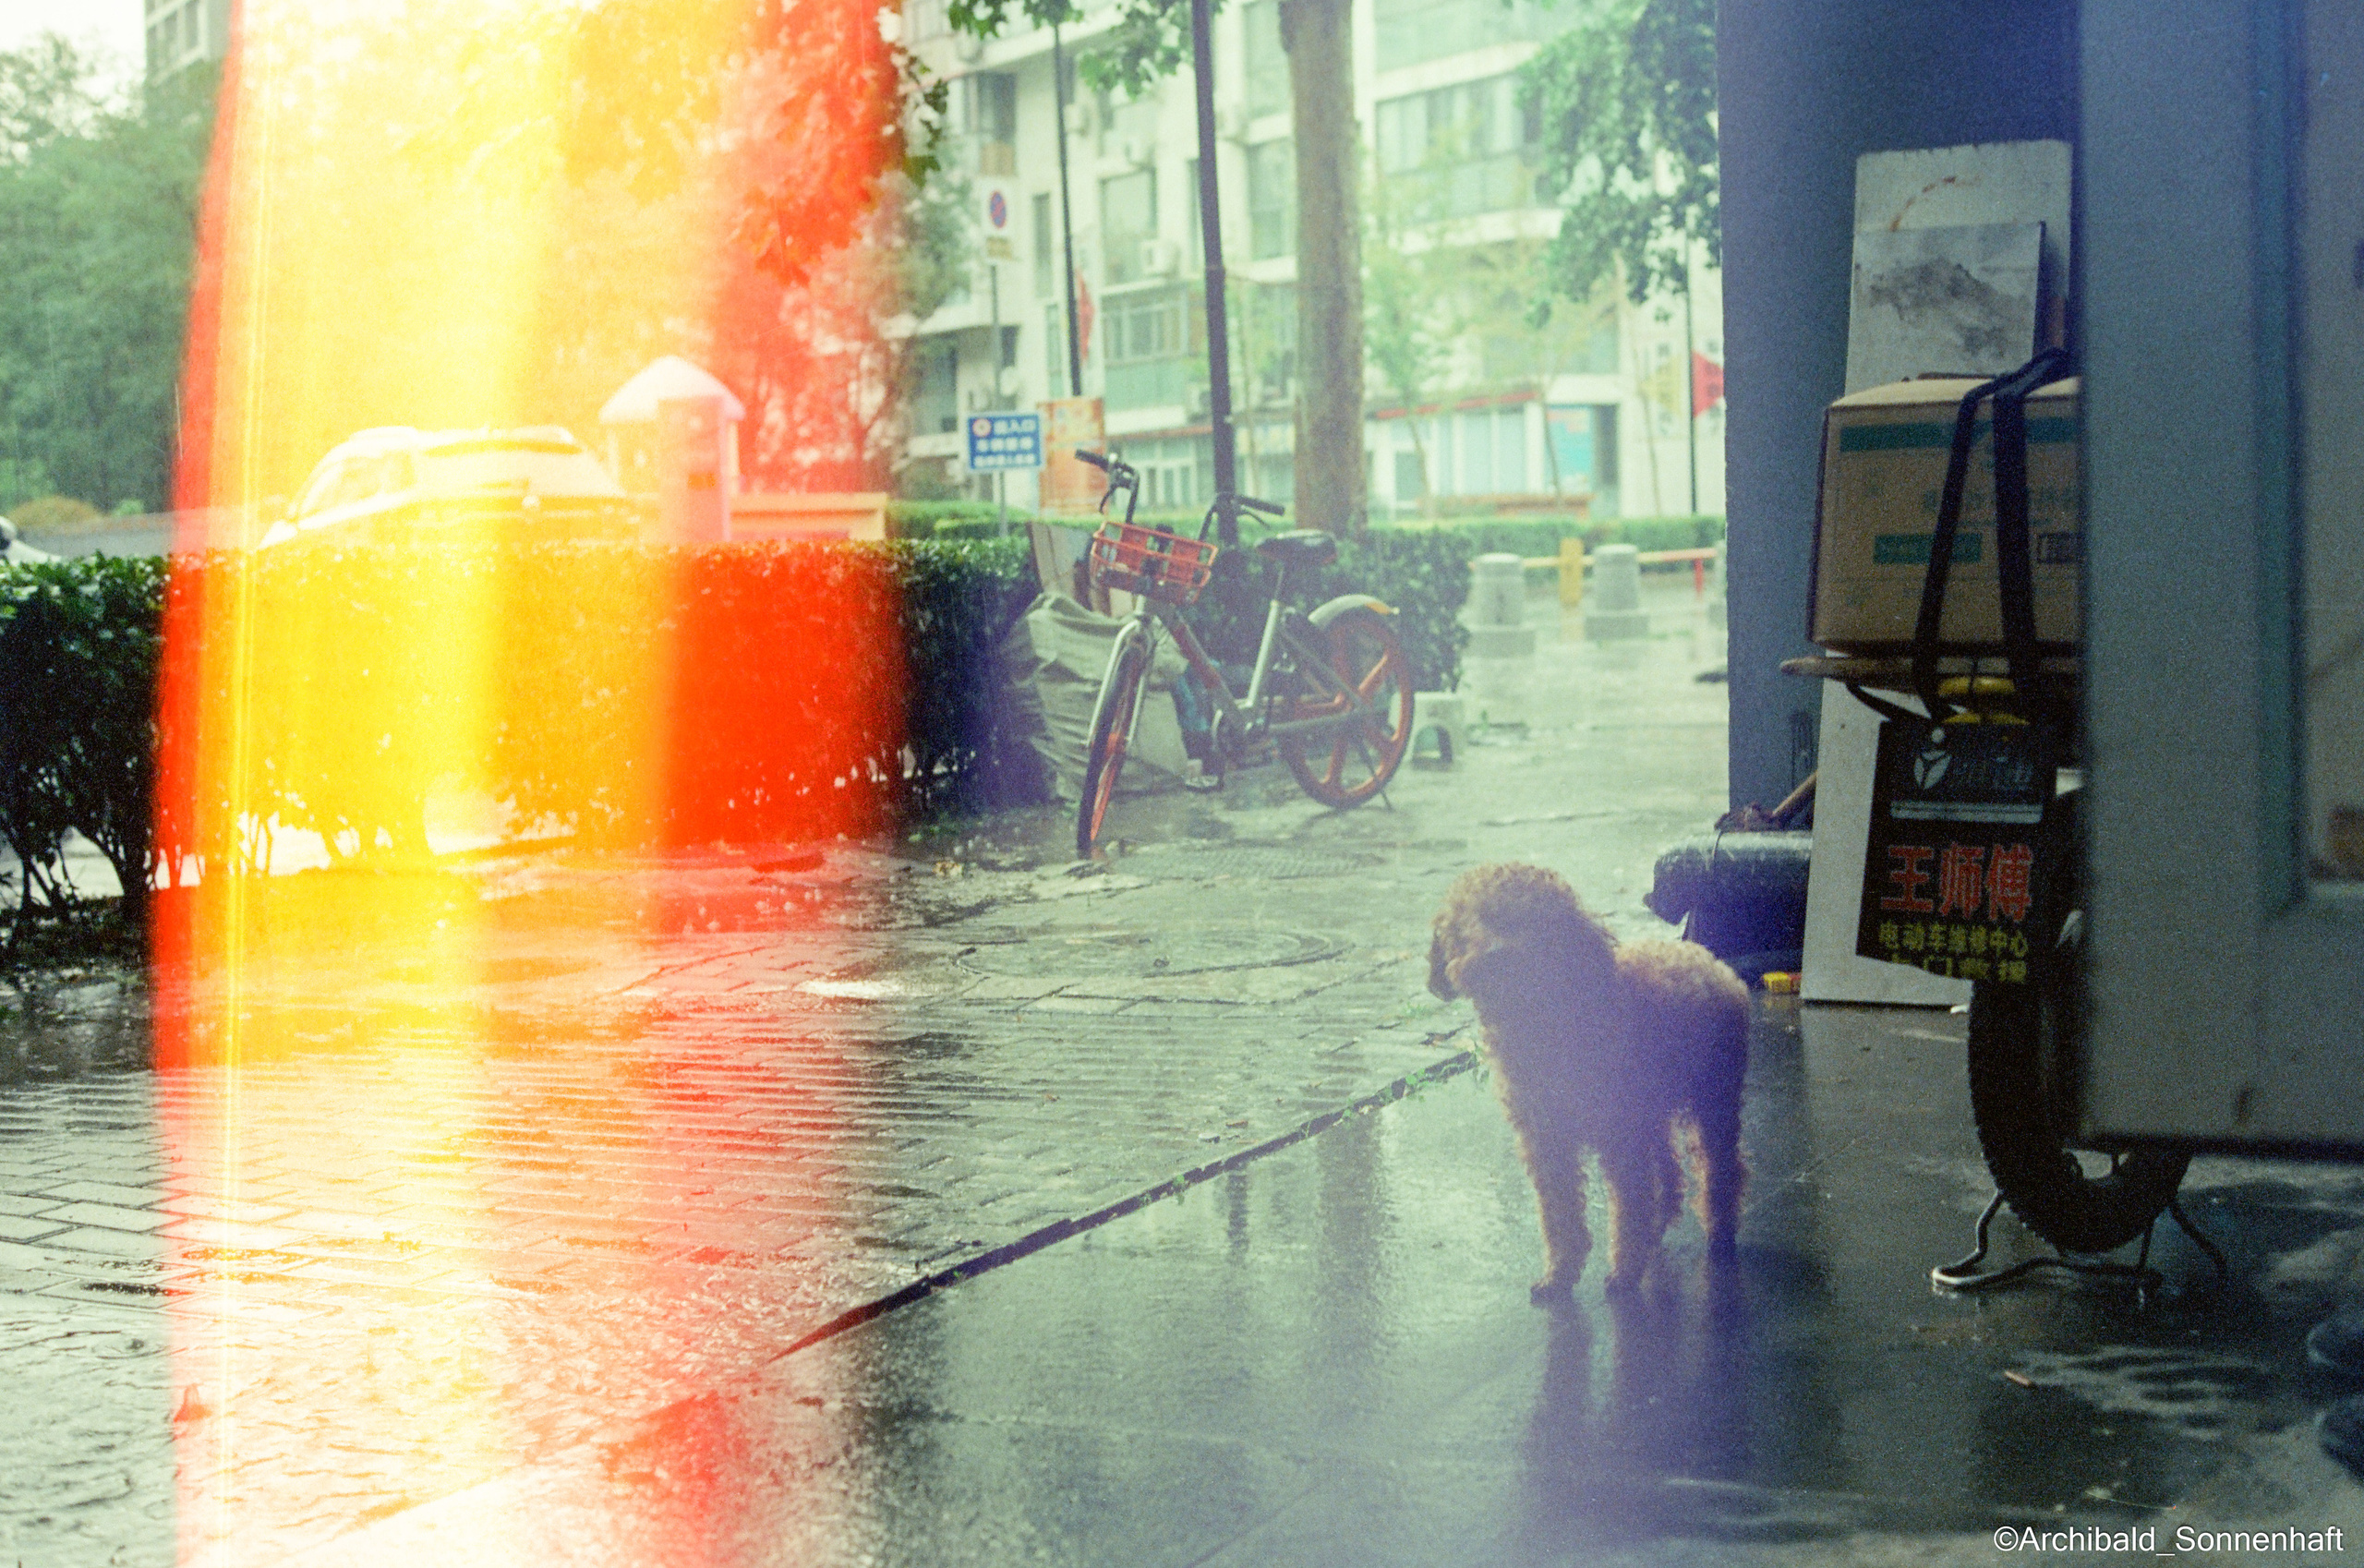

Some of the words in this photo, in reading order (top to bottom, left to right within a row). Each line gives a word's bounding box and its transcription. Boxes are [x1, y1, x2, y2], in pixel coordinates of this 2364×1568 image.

[1880, 841, 2032, 922] 王师傅
[1878, 921, 2029, 958] 电动车维修中心
